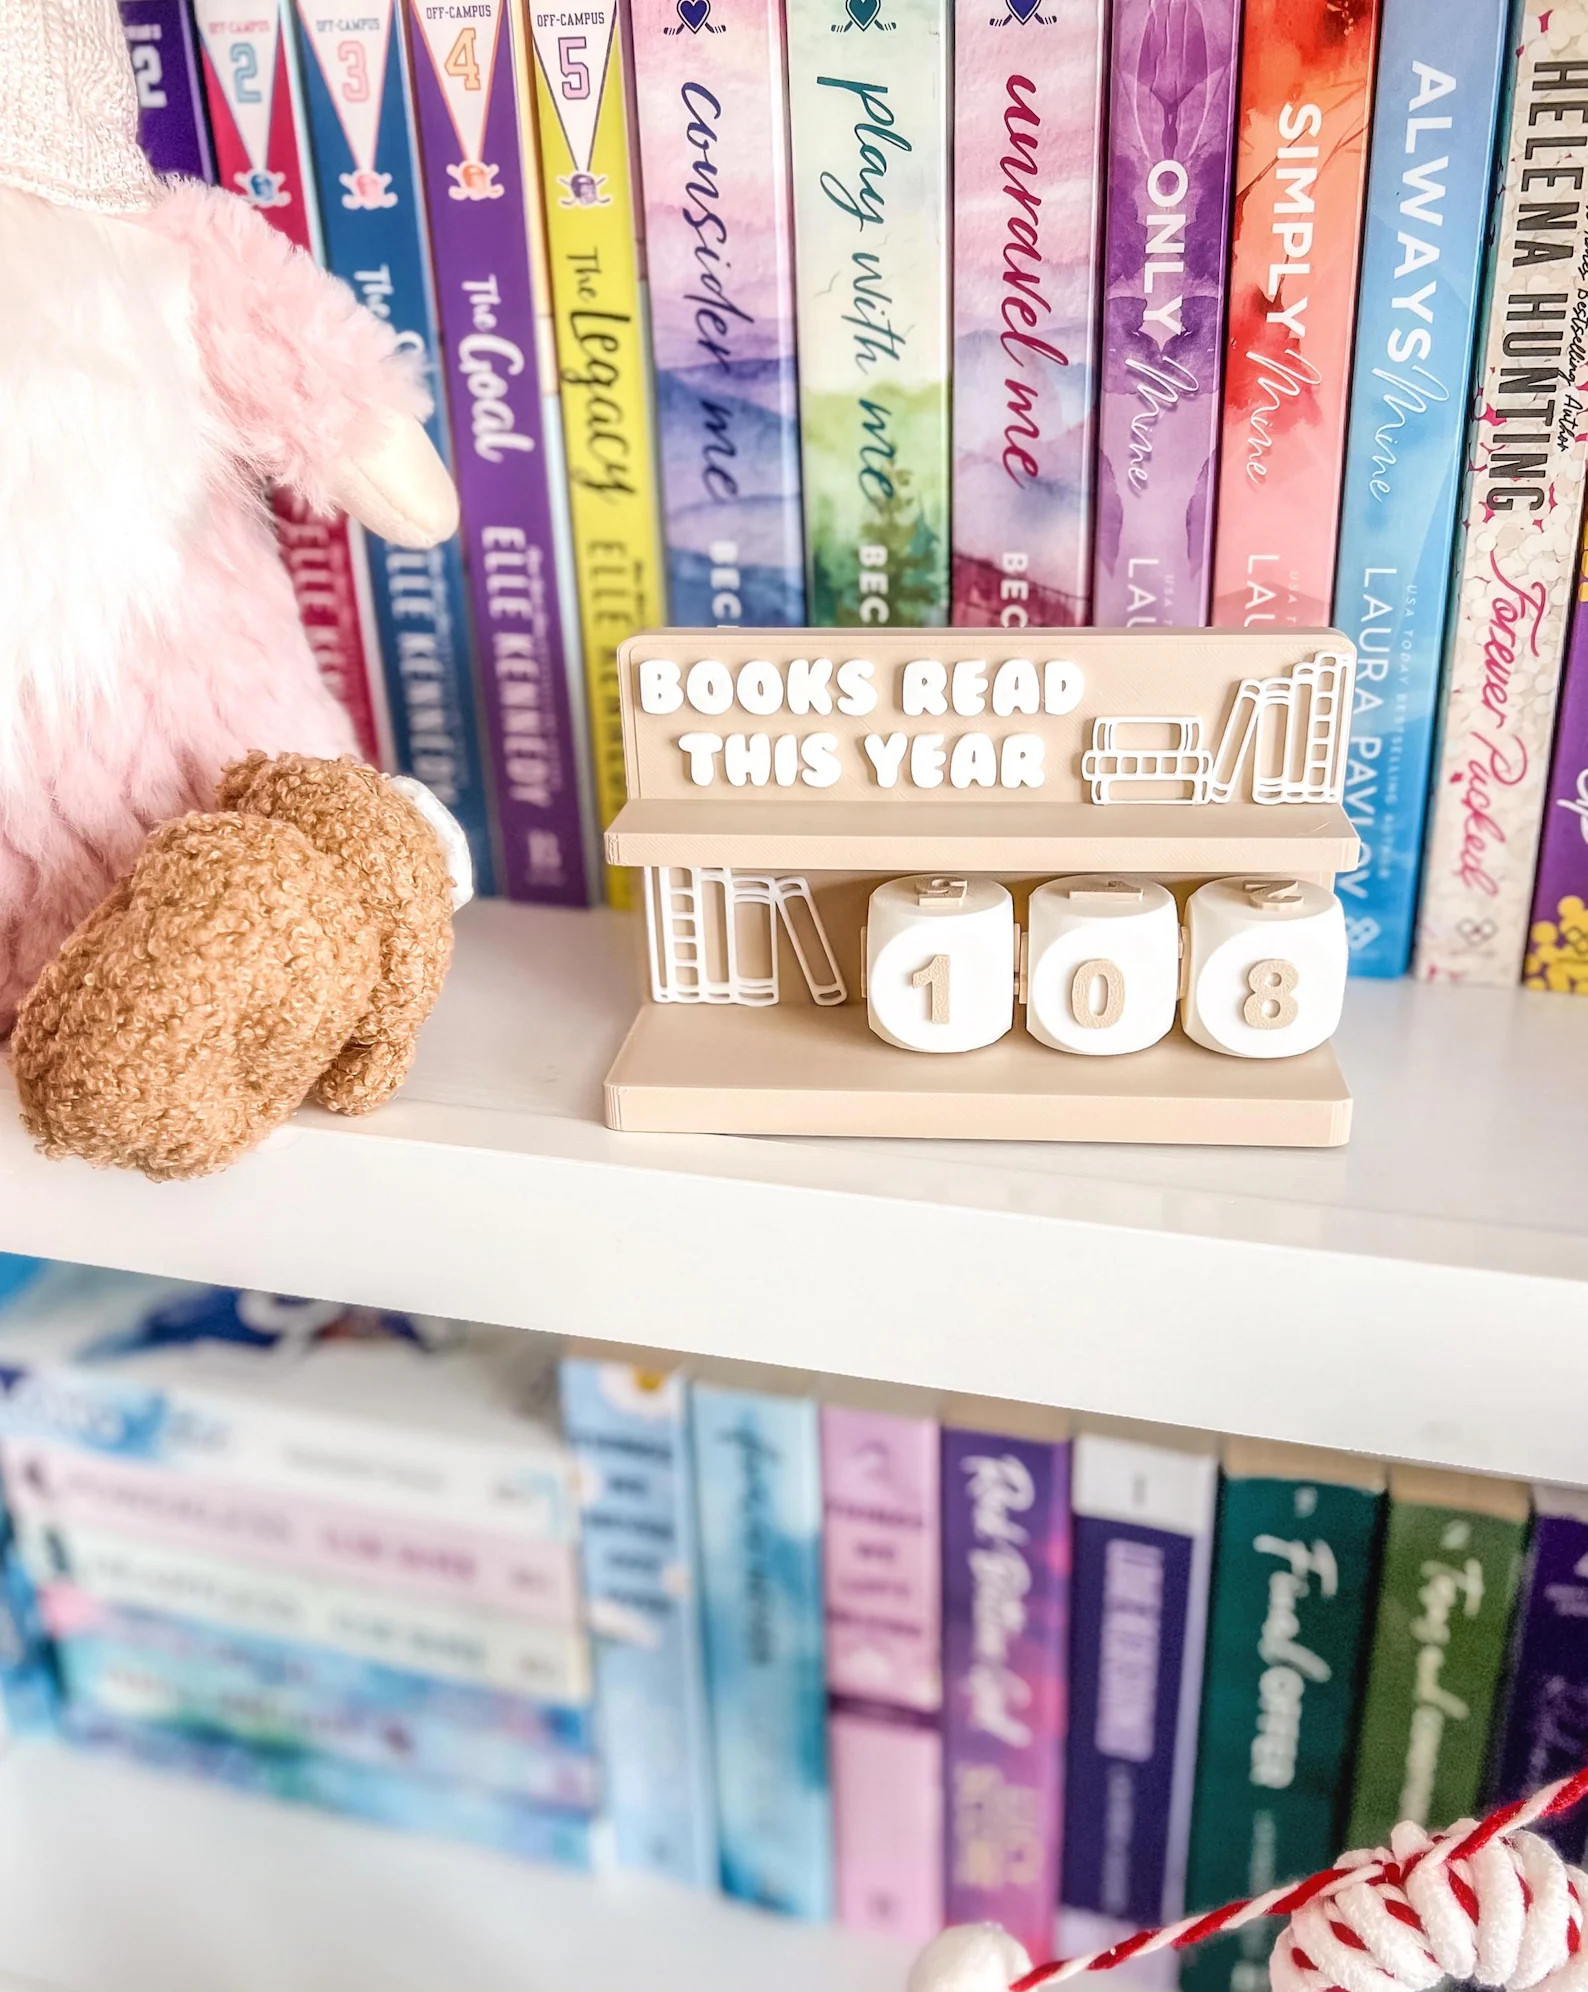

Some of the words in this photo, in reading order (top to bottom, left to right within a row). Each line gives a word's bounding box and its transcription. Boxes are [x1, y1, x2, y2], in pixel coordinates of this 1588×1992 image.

[426, 4, 492, 20] OFF-CAMPUS
[444, 27, 481, 91] 4
[536, 12, 605, 27] OFF-CAMPUS
[229, 43, 262, 103] 2
[337, 40, 370, 102] 3
[558, 36, 590, 100] 5
[816, 75, 912, 233] play
[1512, 60, 1588, 268] HELENA
[999, 74, 1069, 368] unravel
[1142, 159, 1189, 336] ONLY
[1265, 102, 1322, 339] SIMPLY
[1386, 59, 1457, 363] ALWAYS
[461, 273, 501, 331] The
[565, 245, 602, 303] The
[841, 251, 906, 375] with
[458, 333, 535, 464] Goal
[560, 310, 638, 500] Legacy
[1002, 378, 1040, 490] me
[1125, 355, 1200, 492] Mine
[1245, 348, 1322, 487] Mine
[1368, 364, 1450, 504] Mine
[1486, 292, 1569, 511] HUNTING
[1557, 393, 1583, 452] Author
[702, 398, 738, 498] me
[857, 398, 898, 505] me
[385, 543, 438, 621] LLE
[481, 526, 533, 620] ELLE
[588, 540, 634, 626] ELLE
[709, 540, 742, 628] BEC
[1163, 574, 1176, 608] USA
[1287, 571, 1299, 604] USA
[1404, 584, 1417, 617] USA
[638, 657, 878, 716] BOOKS
[902, 657, 1085, 717] READ
[1353, 567, 1398, 714] LAURA
[1398, 629, 1415, 686] TODAY
[1483, 551, 1550, 731] Forever
[678, 732, 842, 788] THIS
[863, 732, 1046, 789] YEAR
